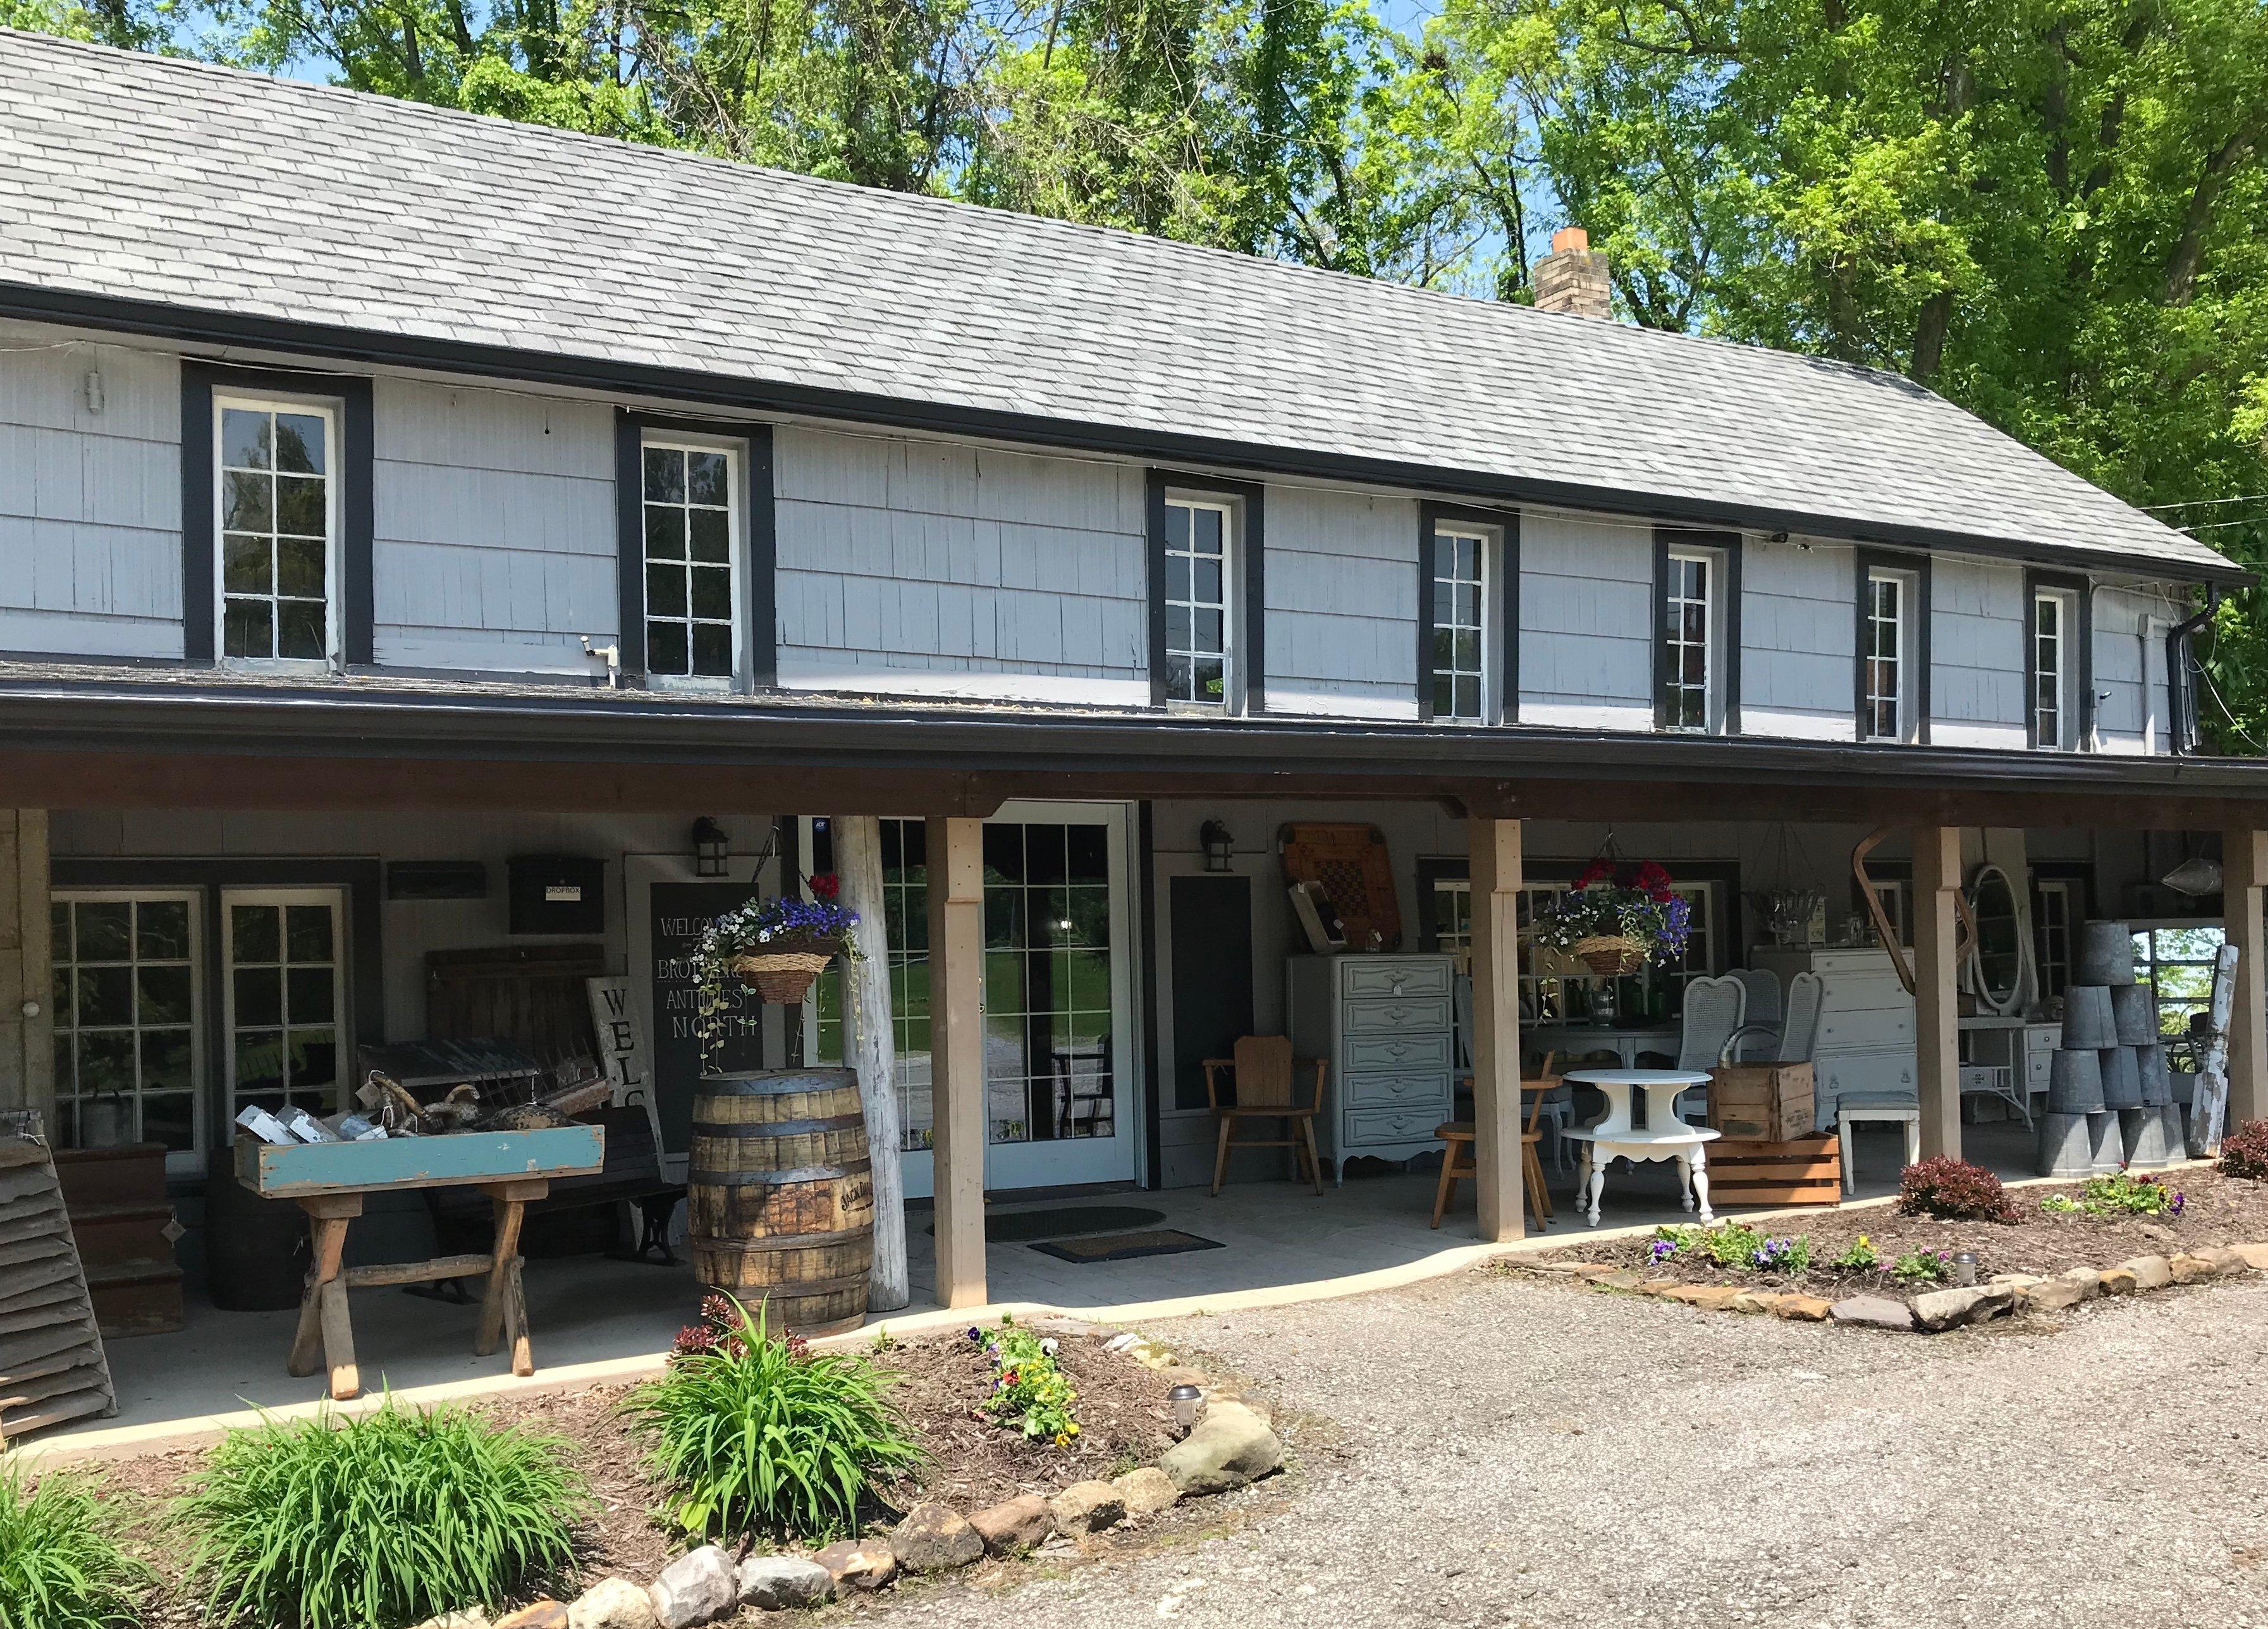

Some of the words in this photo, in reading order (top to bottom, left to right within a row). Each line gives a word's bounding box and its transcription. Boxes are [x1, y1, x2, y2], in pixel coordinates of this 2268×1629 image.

[658, 959, 742, 979] BROT
[673, 1016, 756, 1038] NORTH
[840, 1185, 861, 1211] JACK
